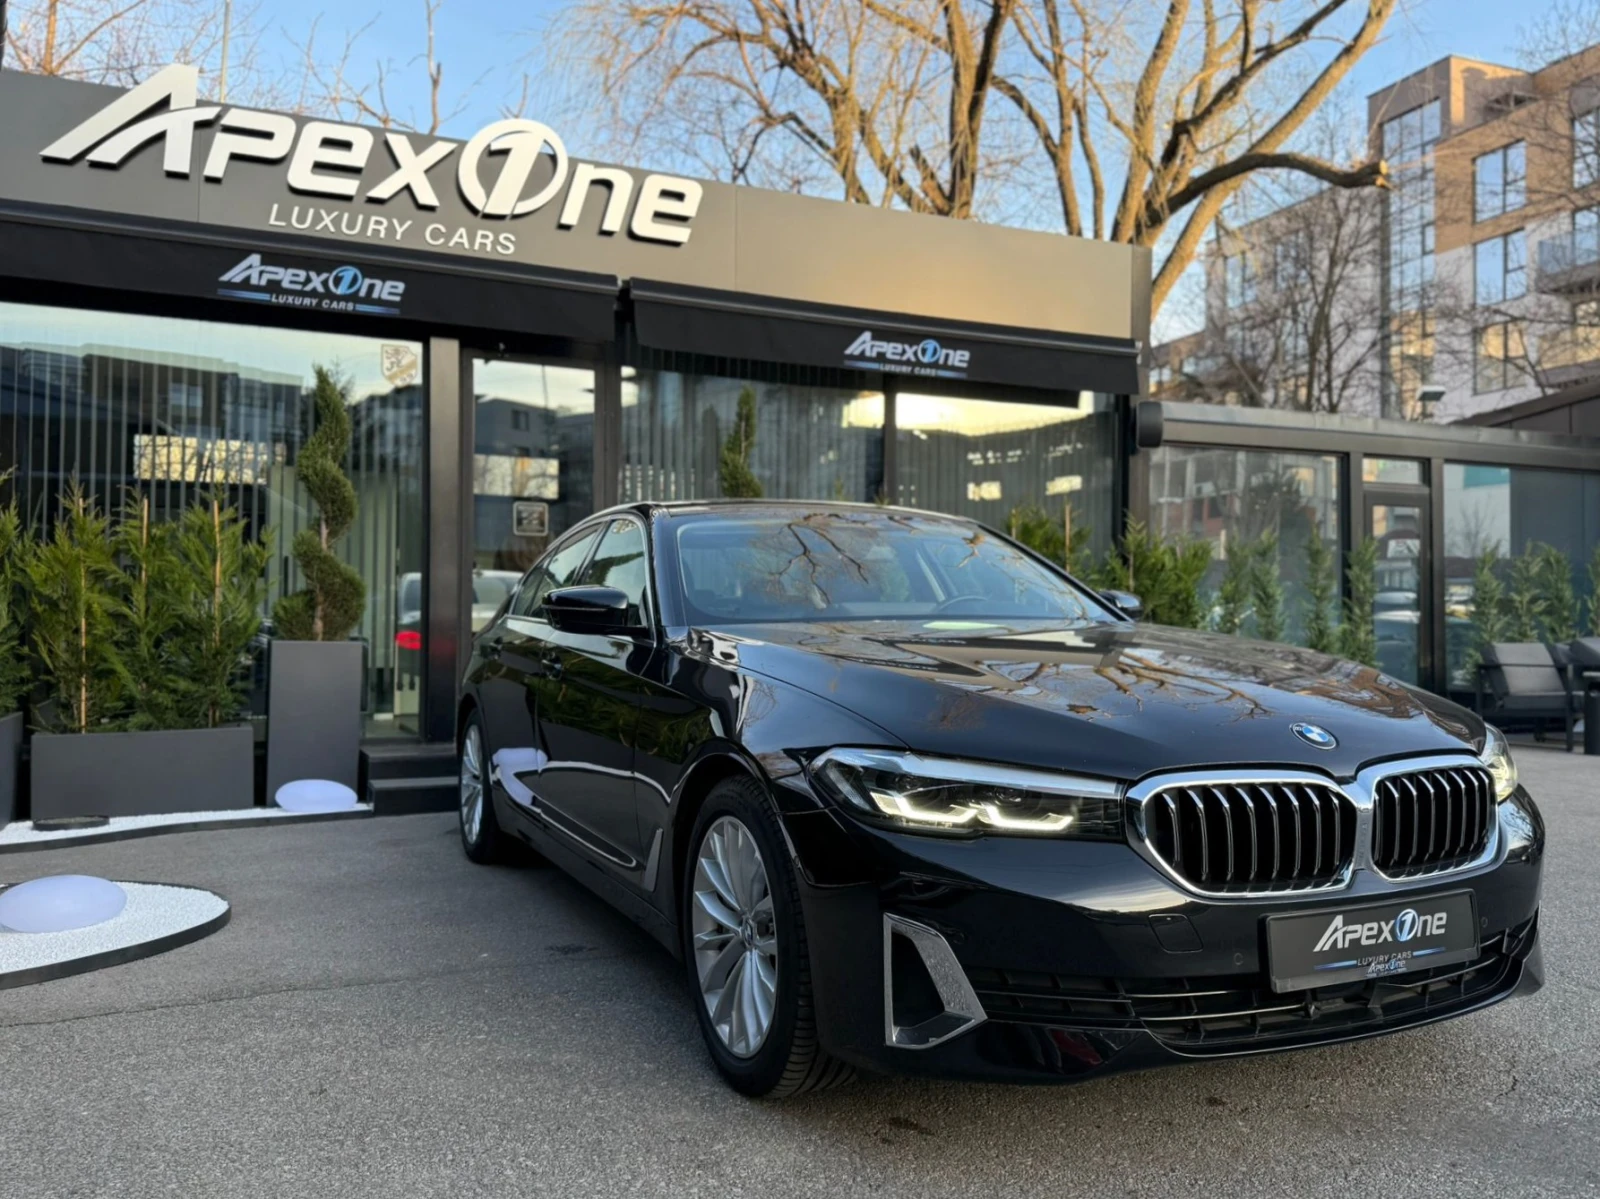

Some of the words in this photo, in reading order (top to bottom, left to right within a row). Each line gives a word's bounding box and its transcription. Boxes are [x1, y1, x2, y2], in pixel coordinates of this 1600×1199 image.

[268, 203, 412, 241] LUXURY
[424, 223, 517, 255] CARS
[271, 294, 319, 307] LUXURY
[322, 299, 354, 311] CARS
[879, 363, 912, 374] LUXURY
[914, 366, 937, 377] CARS
[1357, 954, 1390, 966] LUXURY
[1391, 950, 1412, 961] CARS
